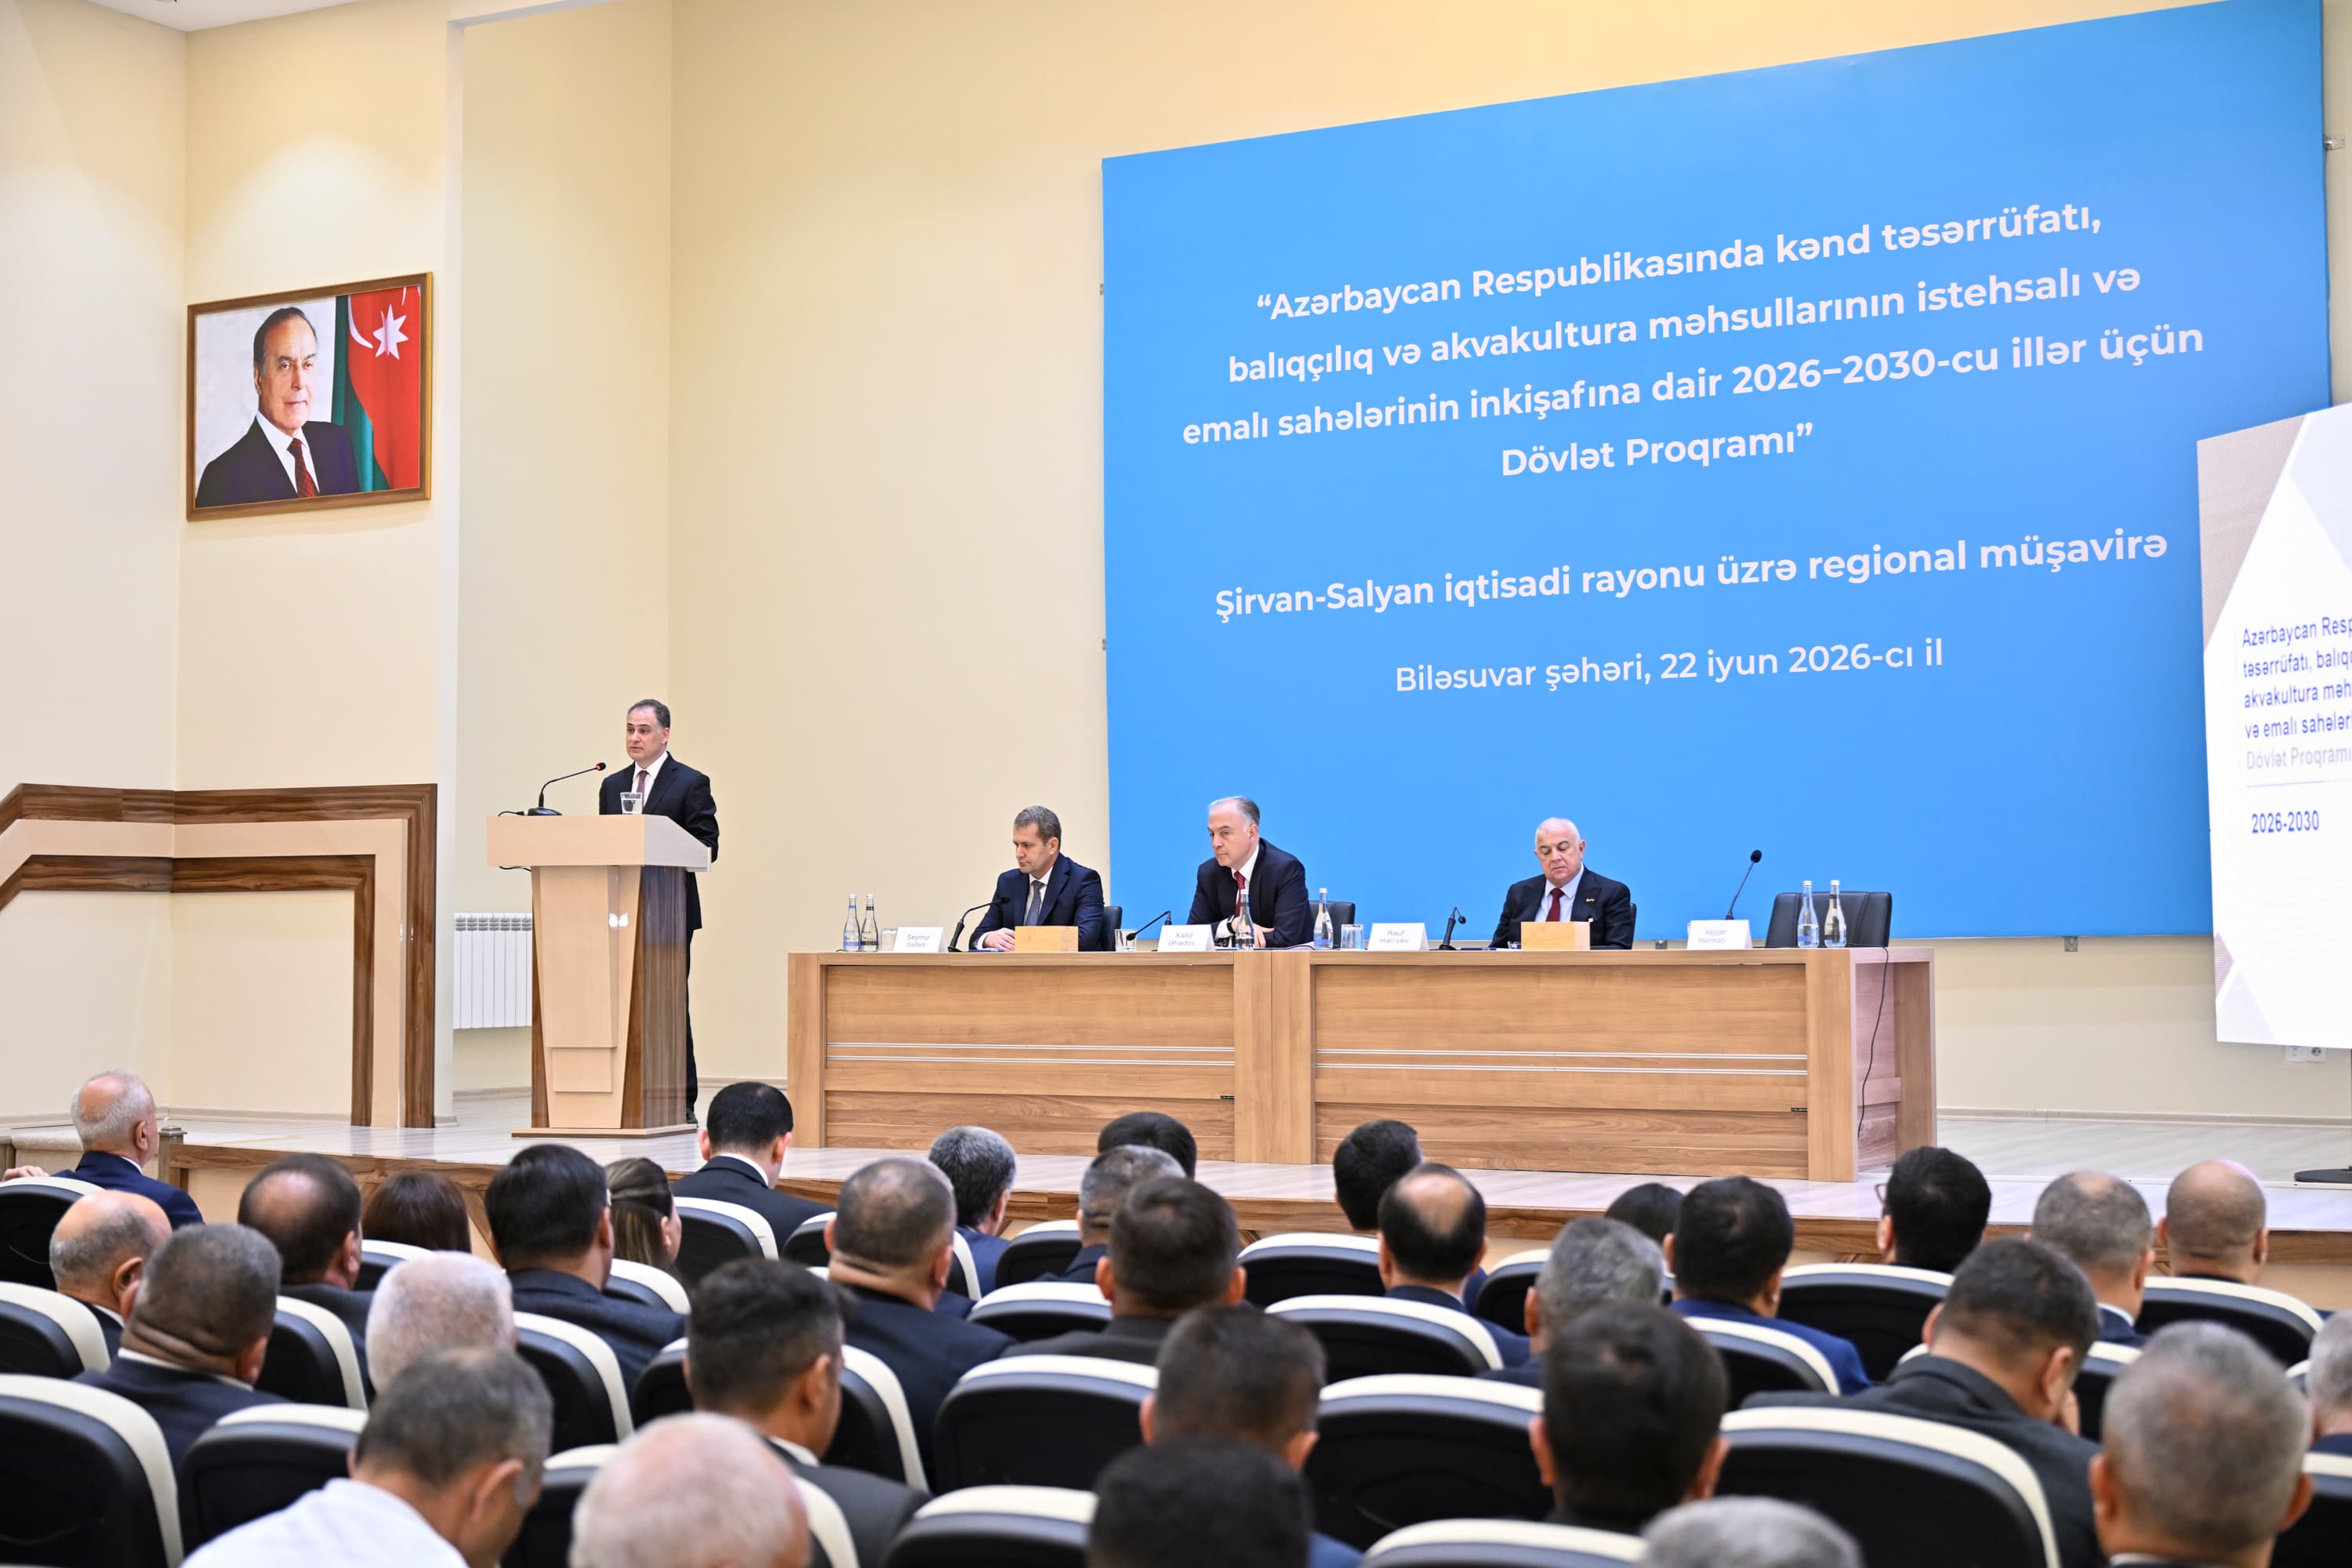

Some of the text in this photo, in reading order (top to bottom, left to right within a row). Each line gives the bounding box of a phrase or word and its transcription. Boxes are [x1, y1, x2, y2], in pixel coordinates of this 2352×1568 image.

[1257, 204, 2101, 320] “Azərbaycan Respublikasında kənd təsərrüfatı,
[1229, 267, 2141, 383] balıqçılıq və akvakultura məhsullarının istehsalı və
[1183, 323, 2204, 445] emalı sahələrinin inkişafına dair 2026–2030-cu illər üçün
[1502, 422, 1813, 477] Dövlət Proqramı”
[1216, 528, 2168, 624] Şirvan-Salyan iqtisadi rayonu üzrə regional müşavirə
[2242, 623, 2317, 647] Azərbaycan
[1396, 637, 1942, 691] Biləsuvar şəhəri, 22 iyun 2026-cı il
[2243, 648, 2352, 678] təsərrüfatı, balıq
[2245, 684, 2318, 708] akvakultura
[2245, 724, 2259, 739] və
[2263, 716, 2297, 737] emalı
[2246, 749, 2288, 771] Dövlət
[2251, 809, 2320, 834] 2026-2030
